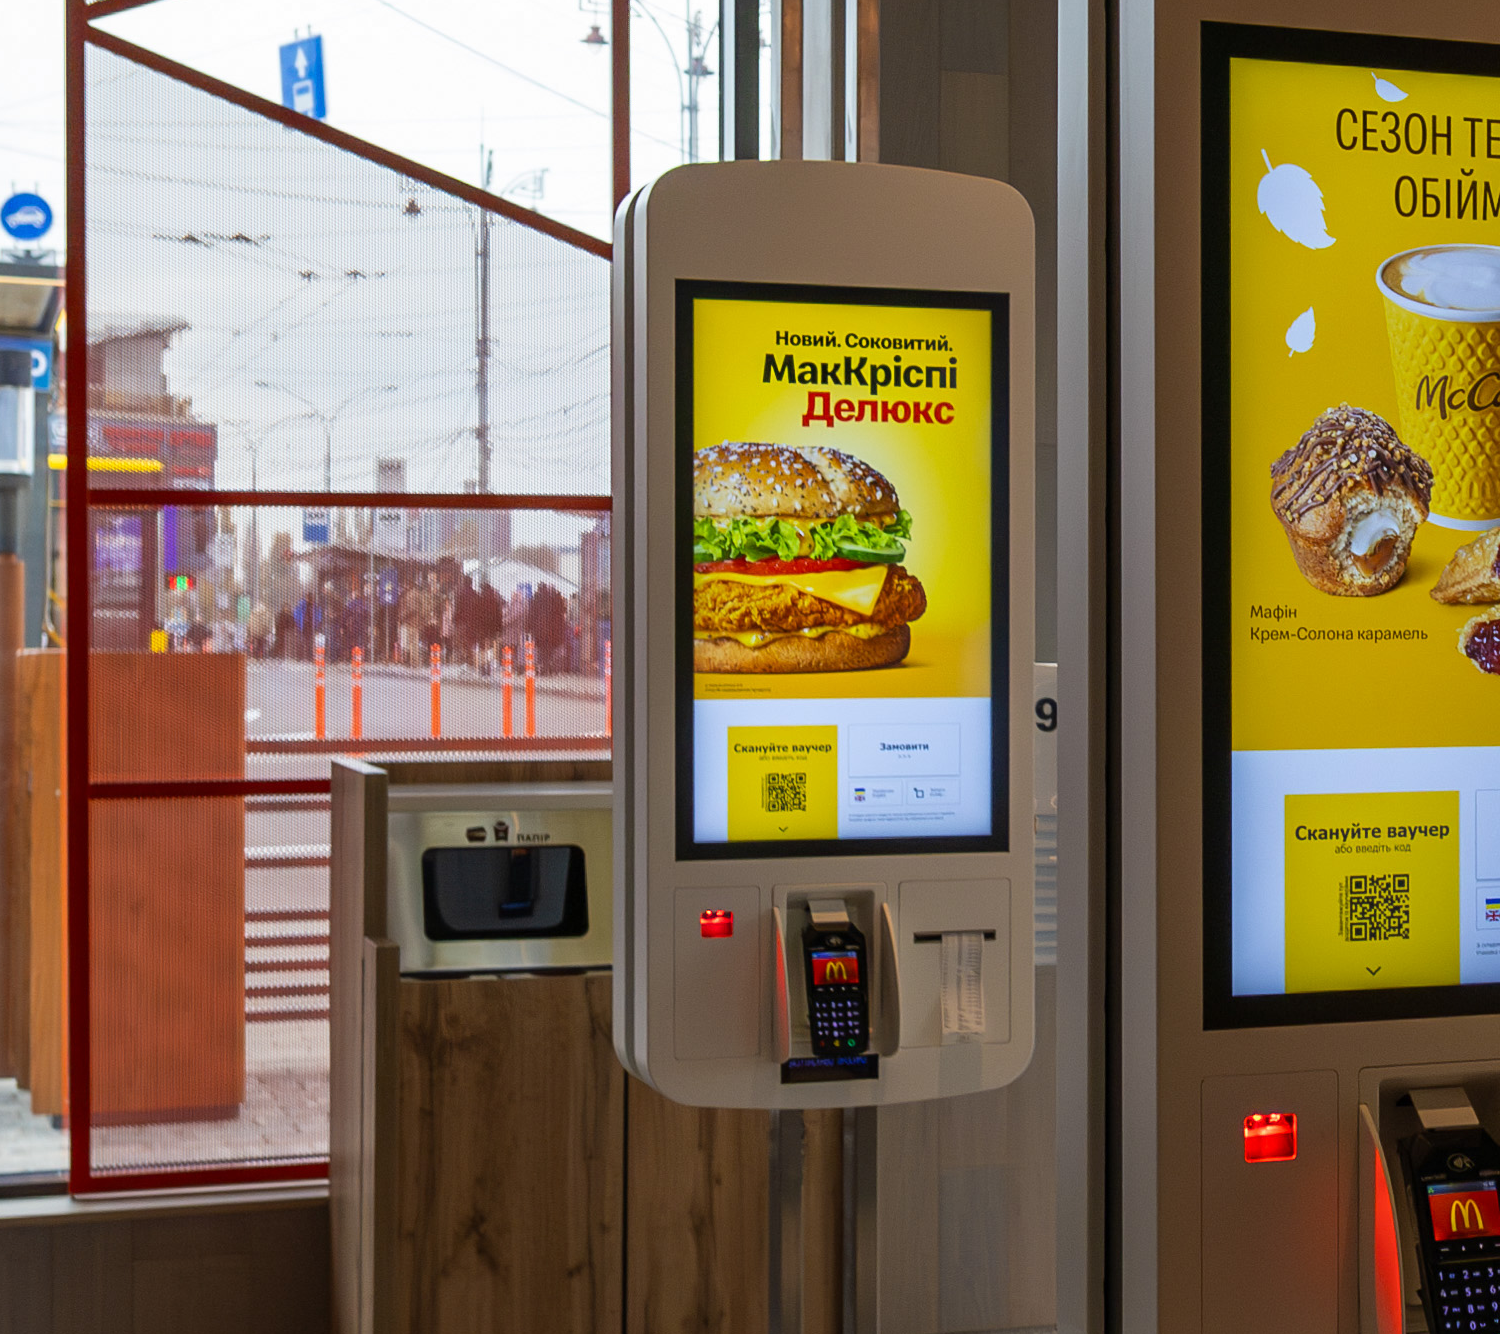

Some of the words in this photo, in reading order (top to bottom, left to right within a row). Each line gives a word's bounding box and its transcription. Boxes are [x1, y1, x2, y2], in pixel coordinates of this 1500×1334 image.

[1335, 108, 1452, 156] СЕЗОН
[775, 330, 841, 348] Новий.
[845, 333, 953, 352] Соковитий.
[762, 353, 957, 395] МакКріспі
[801, 391, 955, 428] Делюкс
[1249, 604, 1298, 621] Мафін
[1249, 625, 1354, 643] Крем-Солона
[1357, 628, 1429, 643] карамель
[1035, 697, 1058, 733] 9
[733, 743, 789, 755] Скануйте
[792, 743, 832, 754] ваучер
[879, 742, 930, 751] Замовити
[517, 833, 551, 843] ПАПІР
[1295, 822, 1382, 842] Скануйте
[1387, 824, 1450, 840] ваучер
[1334, 844, 1353, 854] або
[1355, 843, 1391, 854] введіть
[1394, 843, 1412, 853] код
